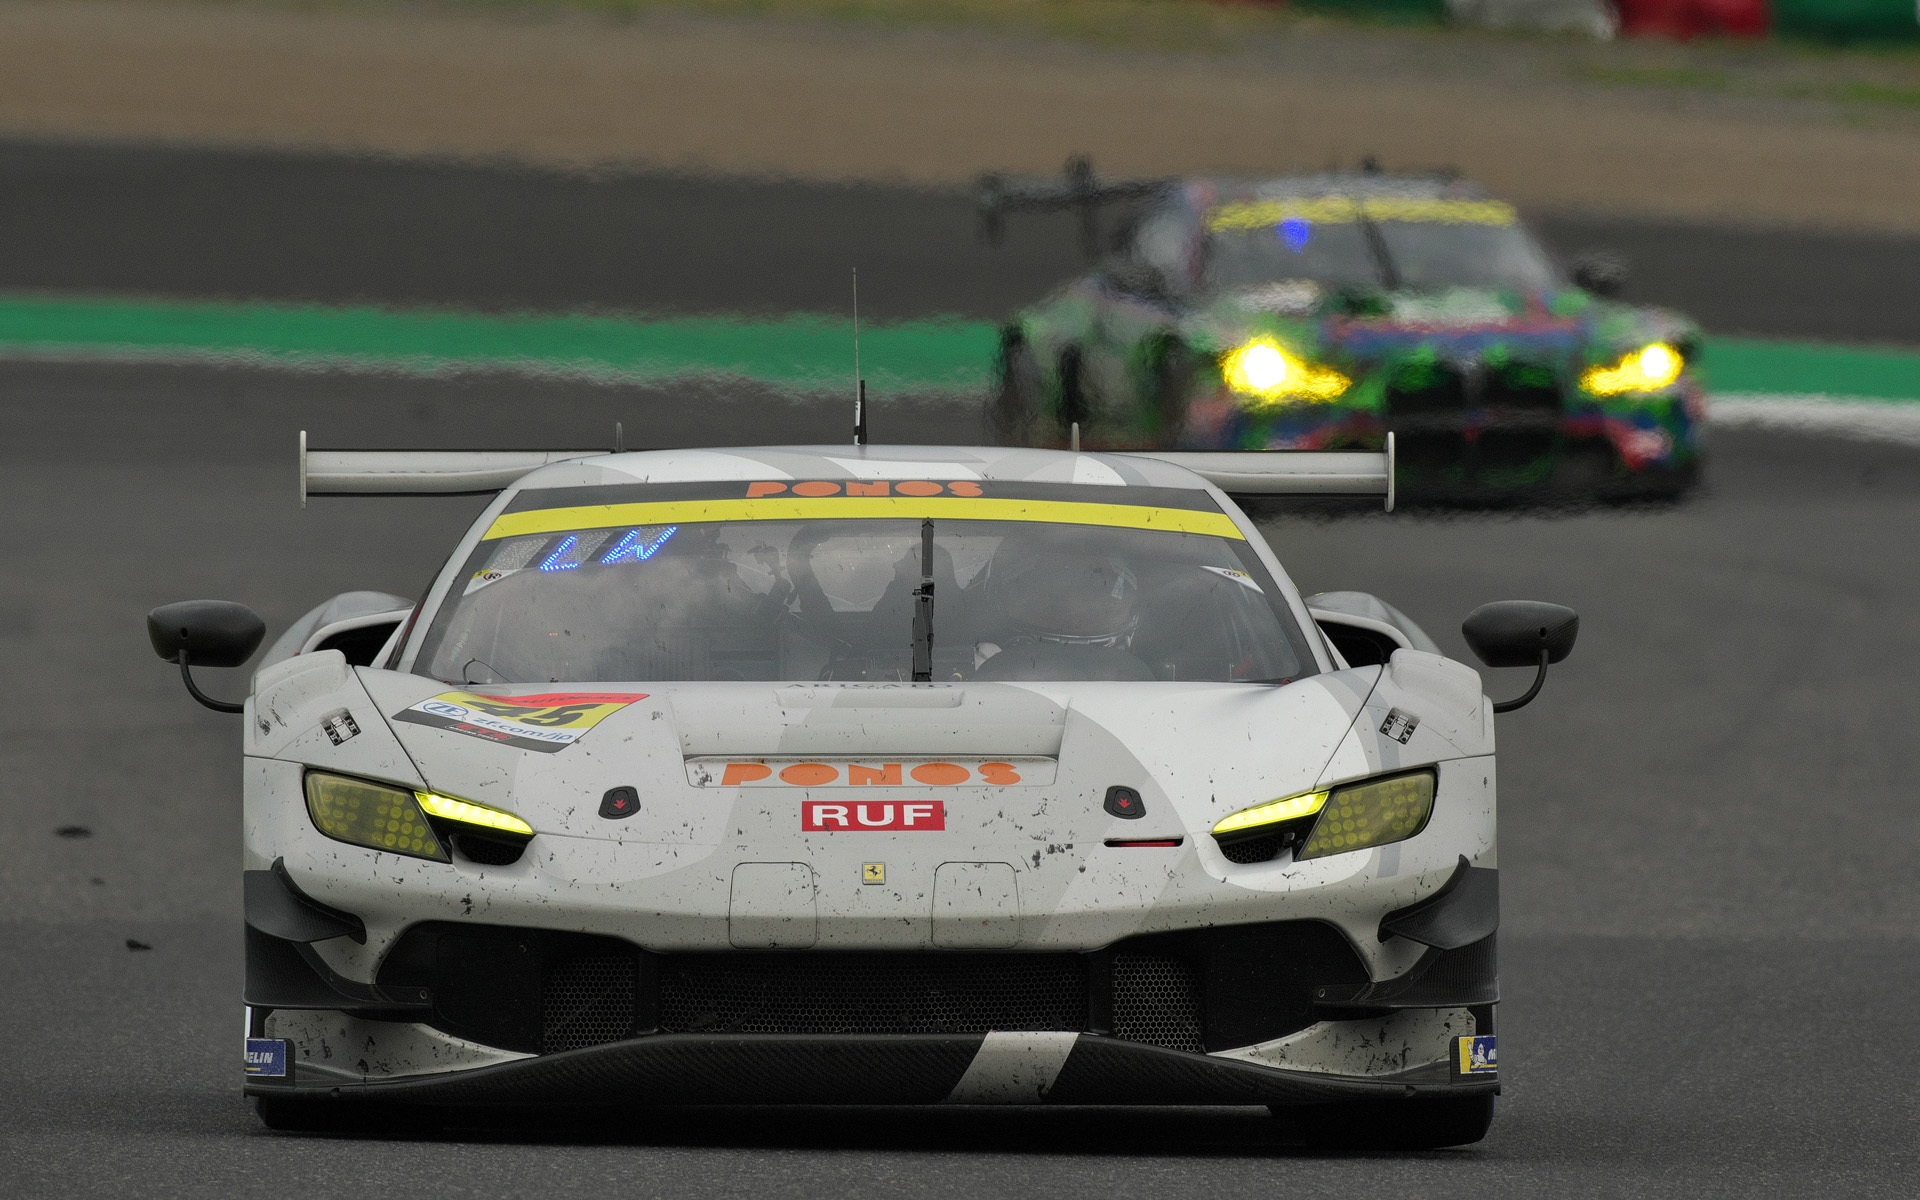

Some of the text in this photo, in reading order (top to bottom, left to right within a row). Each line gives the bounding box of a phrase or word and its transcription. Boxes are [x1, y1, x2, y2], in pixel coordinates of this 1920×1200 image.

[746, 480, 984, 498] PONOS
[427, 703, 464, 715] ZF
[461, 700, 605, 727] 45
[472, 716, 574, 742] zf.com/jp
[720, 762, 1022, 786] PONOS
[812, 804, 934, 827] RUF
